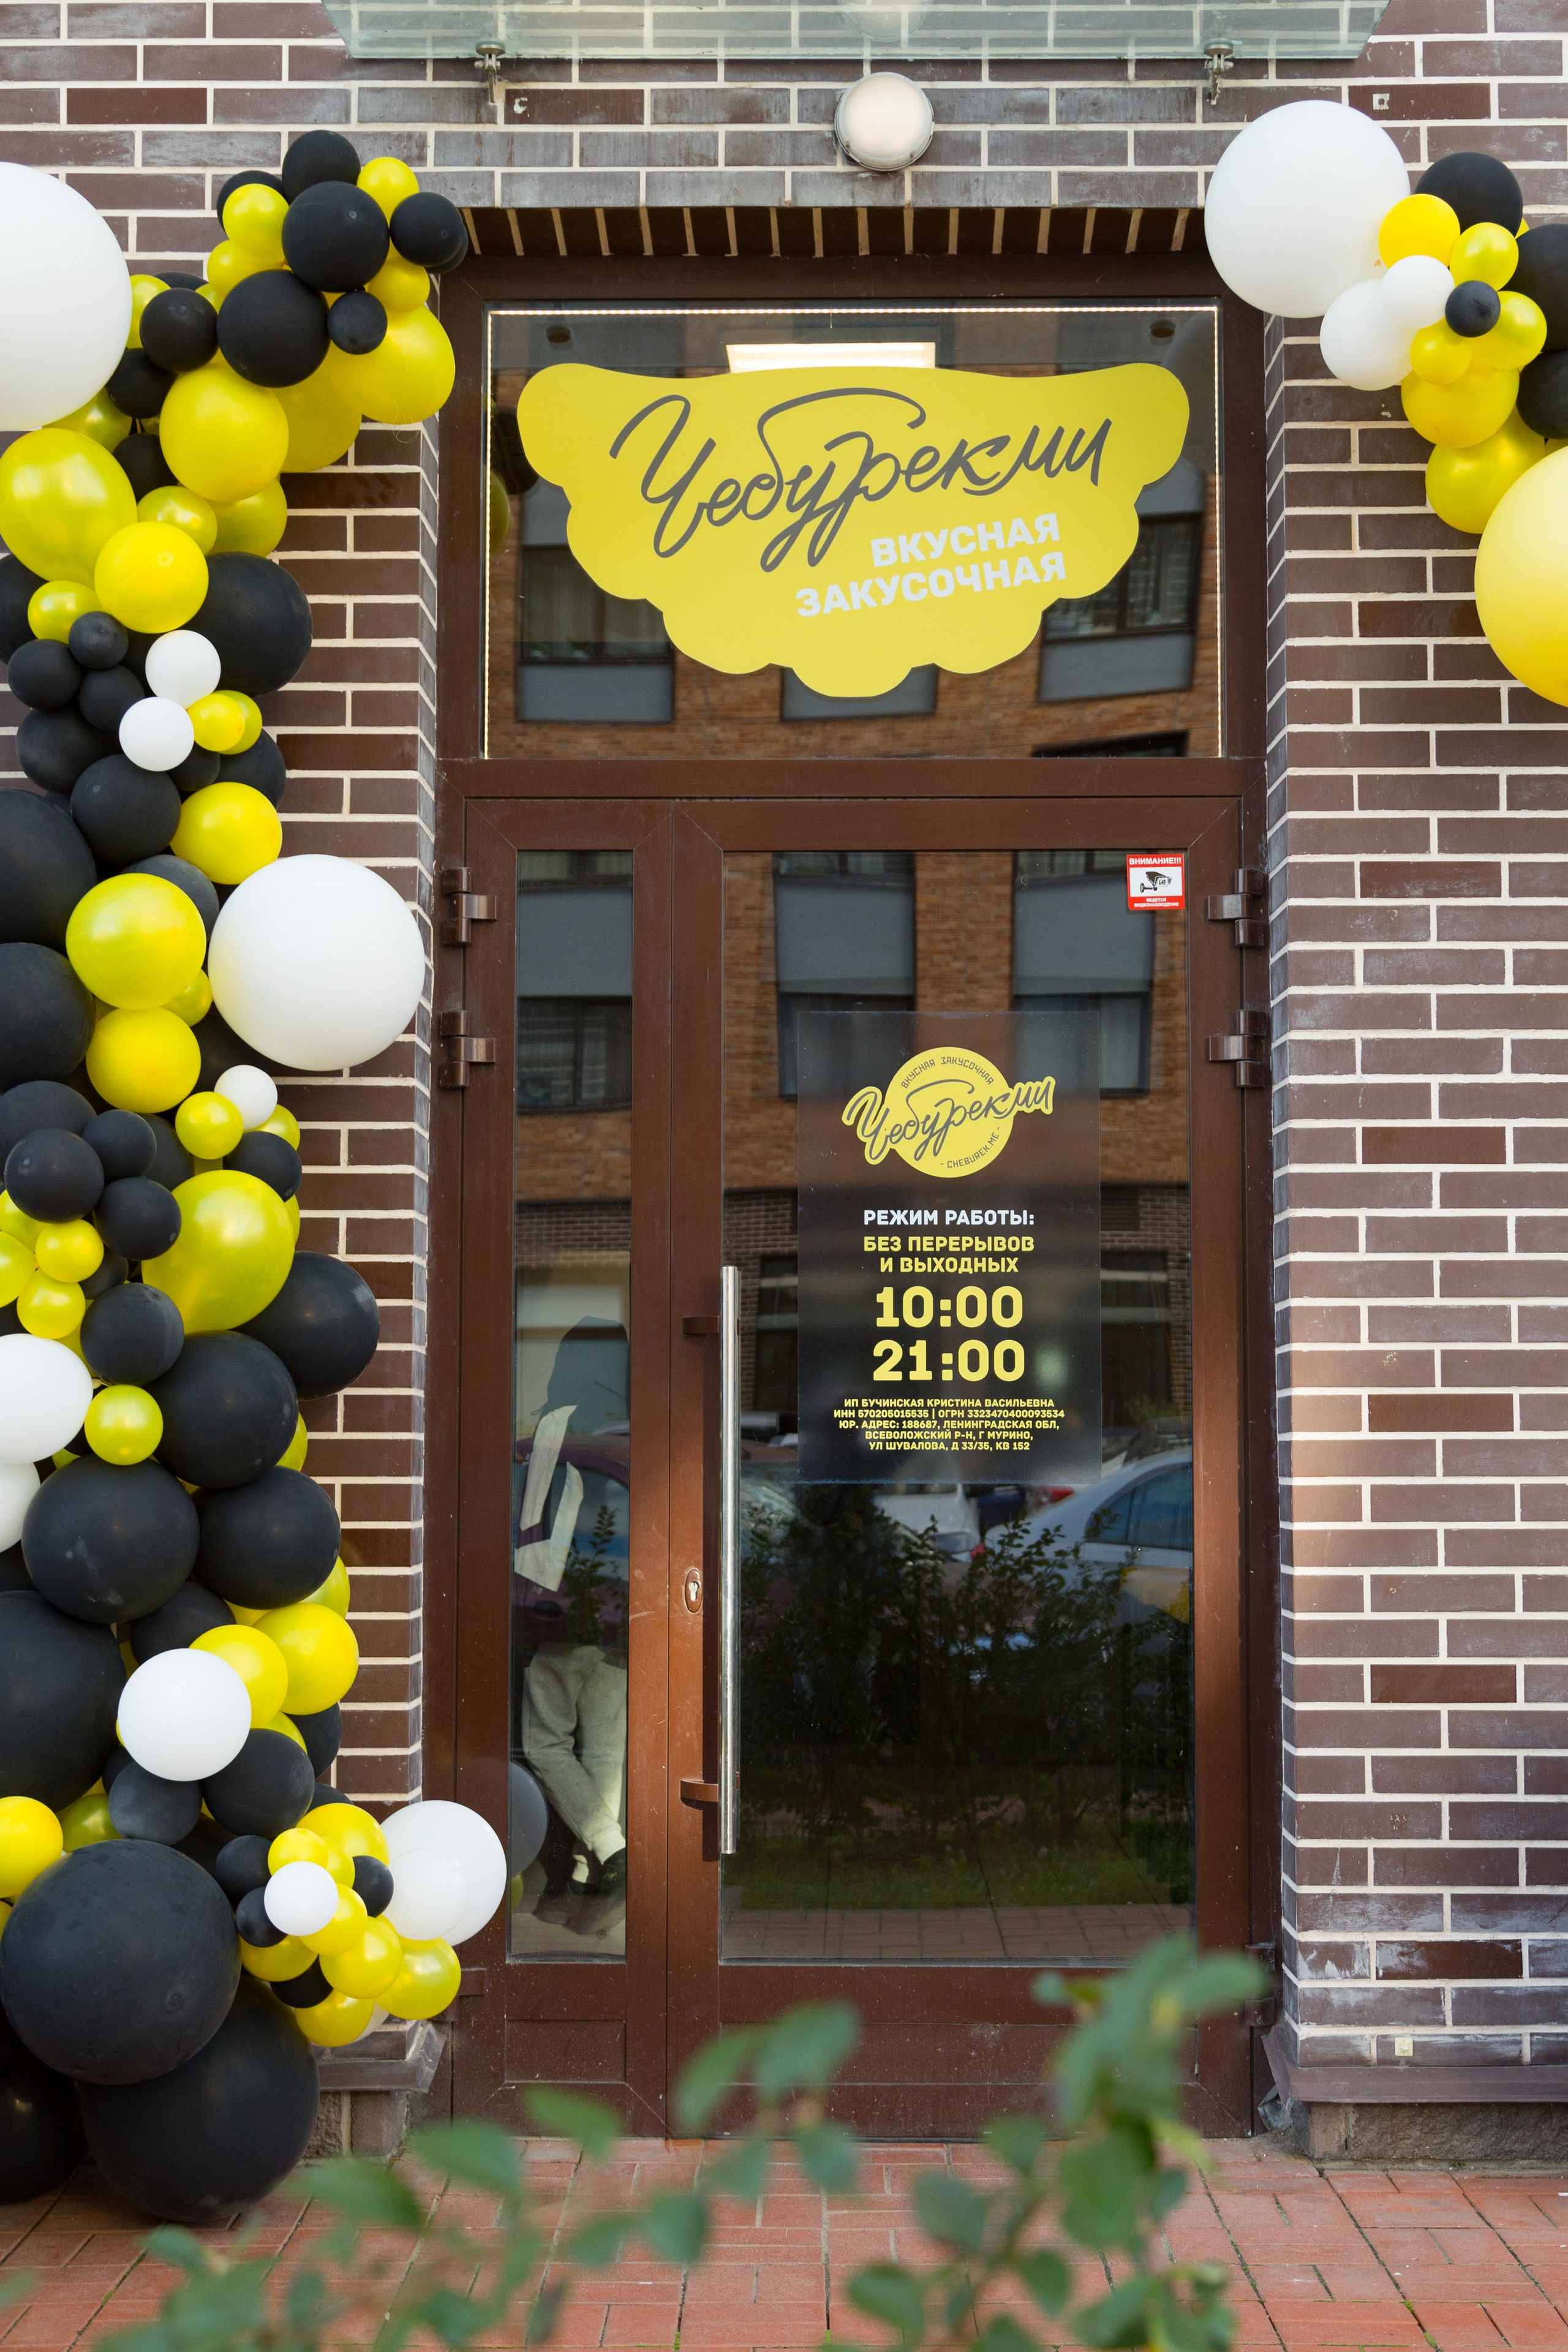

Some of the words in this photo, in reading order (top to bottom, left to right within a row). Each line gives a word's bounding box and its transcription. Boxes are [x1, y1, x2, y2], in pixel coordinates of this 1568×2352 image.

[870, 513, 1060, 568] ВКУСНАЯ
[795, 551, 1066, 617] ЗАКУСОЧНАЯ
[900, 1058, 936, 1089] ВКУСНАЯ
[940, 1056, 995, 1085] ЗАКУСОЧНАЯ
[947, 1132, 1000, 1168] CHEBUREK.ME
[864, 1210, 938, 1225] РЕЖИМ
[945, 1209, 1035, 1226] РАБОТЫ:
[864, 1235, 902, 1252] БЕЗ
[908, 1235, 1035, 1252] ПЕРЕРЫВОВ
[880, 1257, 893, 1273] И
[900, 1257, 1019, 1274] ВЫХОДНЫХ
[876, 1286, 1023, 1328] 10:00
[873, 1339, 1025, 1382] 21:00
[844, 1398, 859, 1408] ИП
[861, 1398, 924, 1408] БУЧИНСКАЯ
[927, 1398, 982, 1408] КРИСТИНА
[984, 1398, 1055, 1408] ВАСИЛЬЕВНА
[834, 1409, 856, 1418] ИНН
[858, 1409, 929, 1418] 570205015535
[938, 1409, 965, 1418] ОГРН
[839, 1420, 859, 1429] ЮР.
[861, 1420, 899, 1430] АДРЕС:
[902, 1420, 941, 1430] 188687,
[943, 1420, 1033, 1430] ЛЕНИНГРАДСКАЯ
[1035, 1420, 1060, 1430] ОБЛ,
[865, 1429, 952, 1440] ВСЕВОЛОЖСКИЙ
[954, 1431, 976, 1441] Р-Н,
[979, 1431, 985, 1439] Г
[987, 1431, 1033, 1441] МУРИНО,
[869, 1441, 883, 1450] УЛ
[886, 1441, 949, 1452] ШУВАЛОВА,
[951, 1441, 959, 1451] Д
[961, 1441, 993, 1452] 33/35,
[995, 1441, 1010, 1450] КВ
[1012, 1441, 1030, 1450] 152
